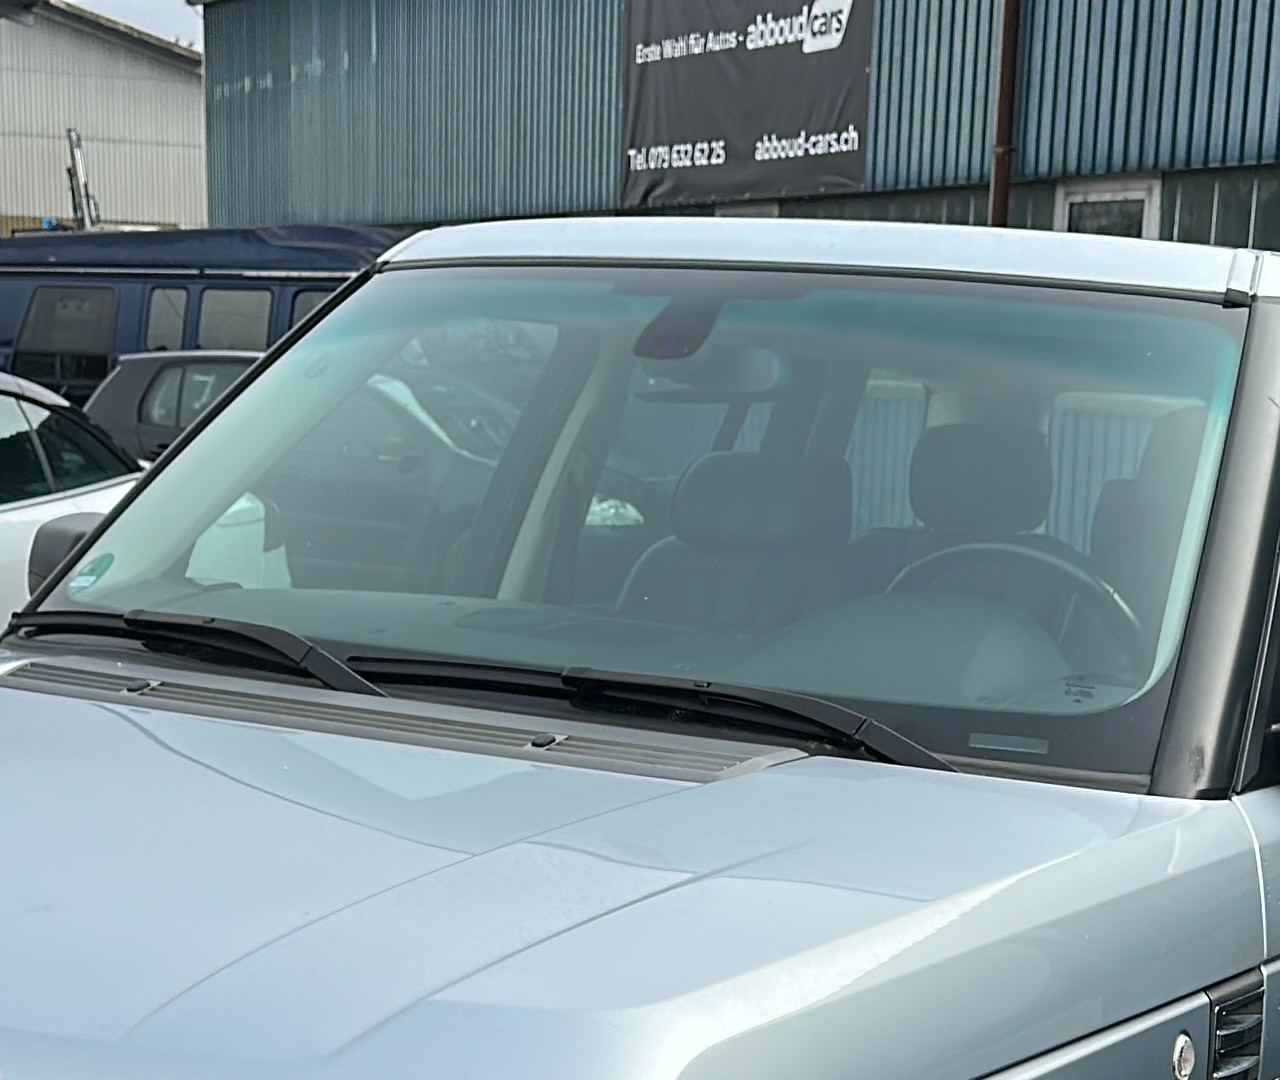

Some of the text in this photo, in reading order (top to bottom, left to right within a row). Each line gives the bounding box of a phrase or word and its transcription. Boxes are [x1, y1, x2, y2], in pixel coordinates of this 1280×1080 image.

[635, 43, 661, 64] Erste
[662, 35, 687, 59] Wahl
[705, 30, 737, 52] Autos
[671, 142, 693, 168] 632
[694, 140, 710, 166] 62
[710, 139, 726, 165] 25
[754, 123, 859, 161] abboud-cars.ch
